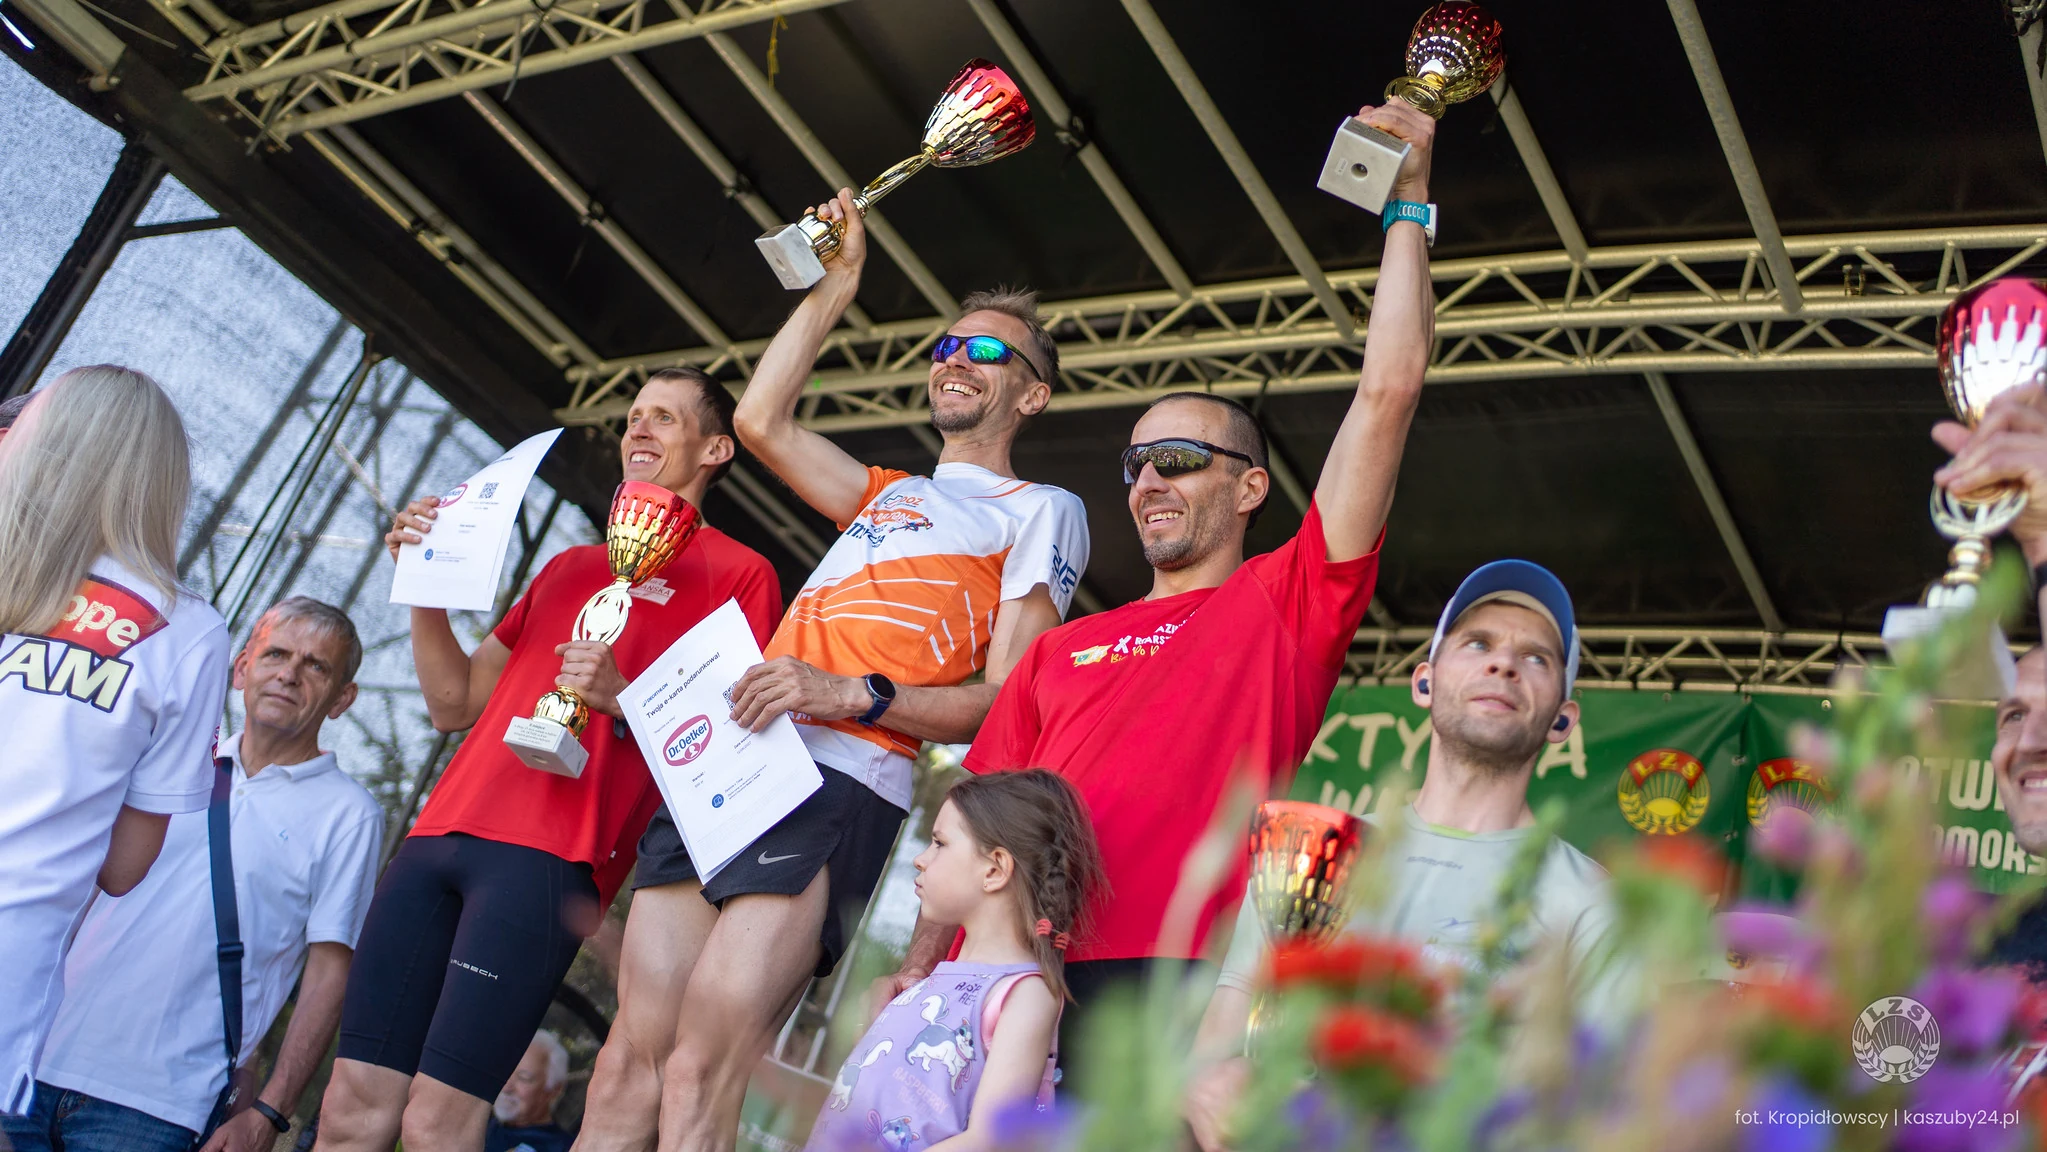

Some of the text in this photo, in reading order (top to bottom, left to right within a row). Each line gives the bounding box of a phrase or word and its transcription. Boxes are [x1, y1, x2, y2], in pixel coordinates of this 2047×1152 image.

[646, 651, 721, 719] Twoja e-karta podarunkowa!
[1633, 752, 1699, 779] LZS
